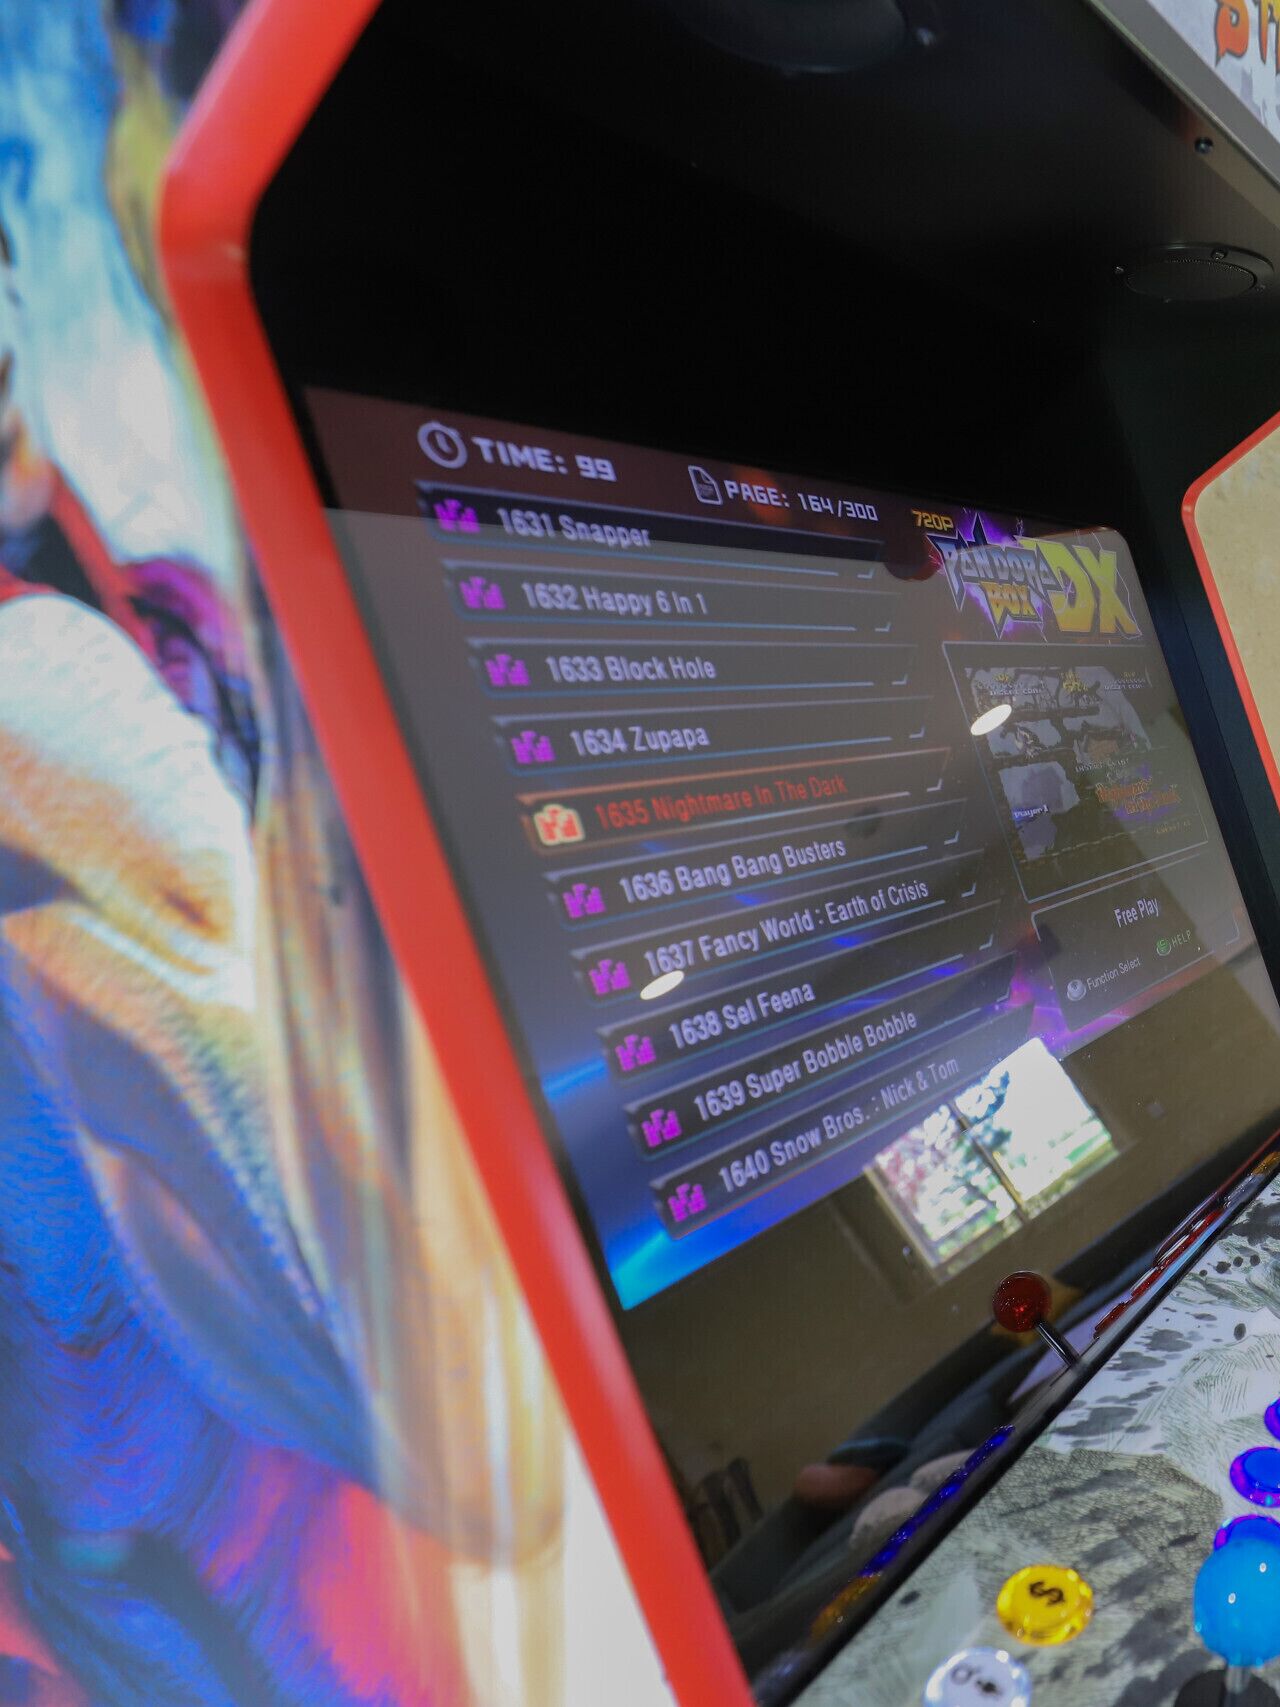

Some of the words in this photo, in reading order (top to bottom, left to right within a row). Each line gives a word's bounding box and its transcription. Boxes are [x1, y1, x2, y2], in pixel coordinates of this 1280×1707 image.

[472, 436, 568, 475] TIME:
[575, 456, 617, 482] 99
[724, 479, 790, 508] PAGE:
[797, 492, 879, 522] 164/300
[911, 509, 955, 532] 720P
[496, 507, 557, 539] 1631
[560, 514, 651, 549] Snapper
[520, 581, 582, 612] 1632
[583, 586, 652, 618] Happy
[655, 590, 672, 614] 6
[695, 592, 709, 616] 1
[546, 655, 603, 683] 1633
[606, 655, 667, 682] Block
[670, 657, 717, 681] Hole
[570, 726, 627, 756] 1634
[628, 725, 709, 753] Zupapa
[594, 798, 651, 831] 1635
[651, 788, 753, 823] Nightmare
[774, 779, 807, 803] The
[808, 774, 848, 799] Dark
[618, 871, 675, 904] 1636
[675, 857, 731, 892] Bang
[731, 848, 784, 881] Bang
[784, 838, 846, 870] Busters
[644, 941, 697, 976] 1637
[697, 923, 761, 960] Fancy
[758, 907, 814, 943] World
[826, 896, 869, 926] Earth
[871, 888, 887, 911] of
[886, 879, 929, 906] Crisis
[1113, 906, 1139, 928] Free
[1138, 898, 1161, 922] Play
[1170, 929, 1193, 949] HELP
[1086, 967, 1120, 991] Function
[1119, 956, 1142, 976] Select
[668, 1009, 721, 1049] 1638
[721, 998, 756, 1029] Sel
[756, 981, 816, 1015] Feena
[693, 1079, 744, 1122] 1639
[746, 1059, 801, 1098] Super
[801, 1033, 864, 1074] Bobble
[863, 1008, 918, 1046] Bobble
[718, 1147, 771, 1193] 1640
[770, 1124, 822, 1164] Snow
[822, 1104, 870, 1138] Bros.
[879, 1079, 915, 1111] Nick
[915, 1071, 928, 1093] &
[927, 1055, 960, 1084] Tom
